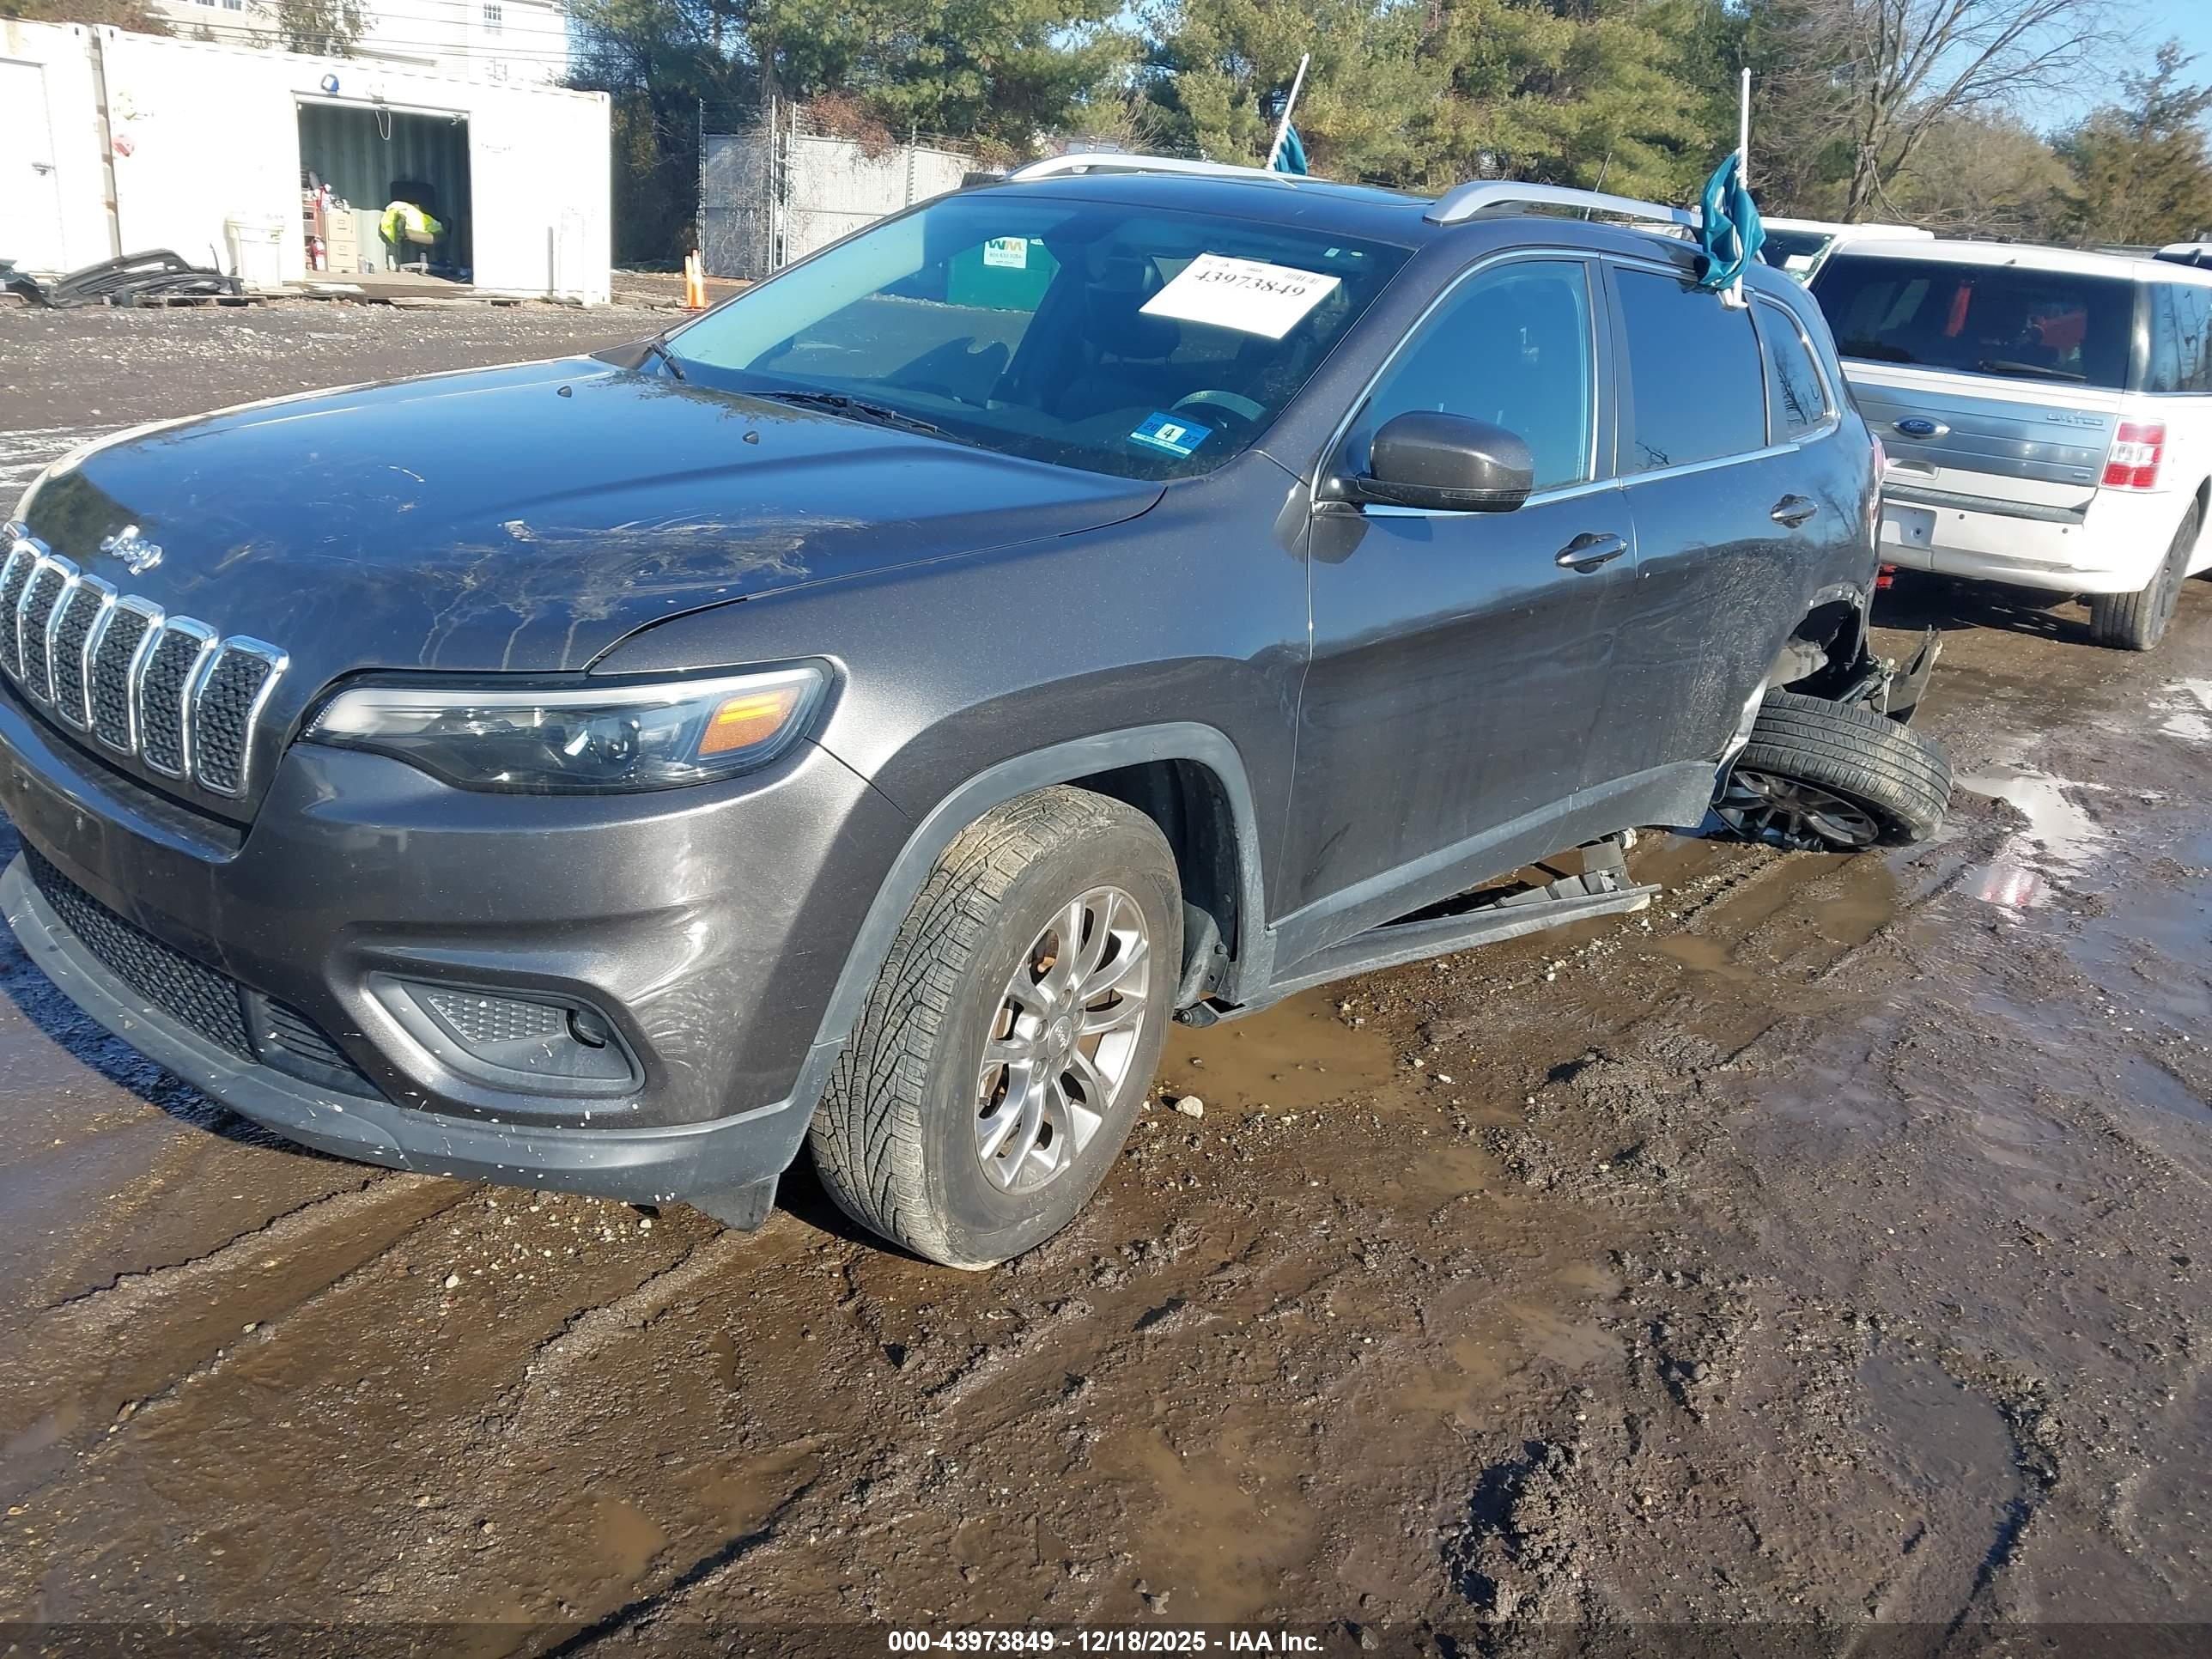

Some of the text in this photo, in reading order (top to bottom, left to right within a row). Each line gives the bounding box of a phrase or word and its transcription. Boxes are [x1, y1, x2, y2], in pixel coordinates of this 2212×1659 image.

[1194, 270, 1306, 297] 43973849
[1143, 422, 1160, 432] 20
[1164, 428, 1176, 439] 4
[1182, 434, 1200, 444] 27
